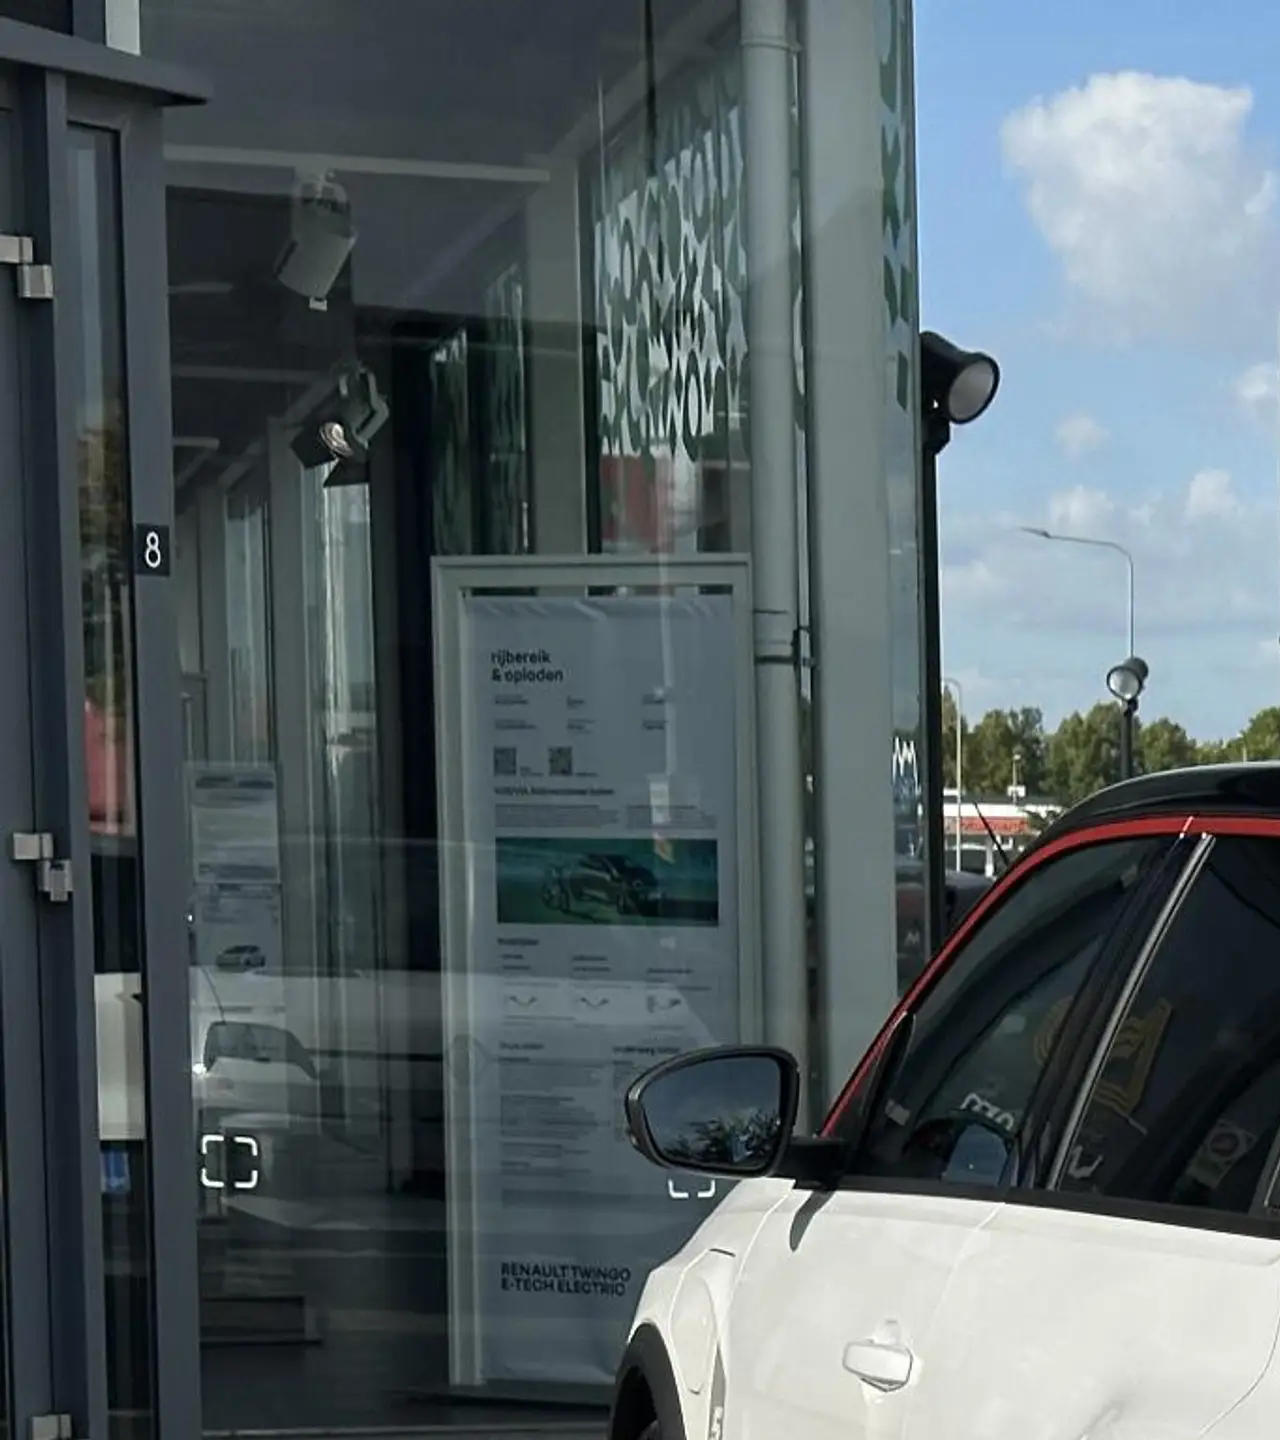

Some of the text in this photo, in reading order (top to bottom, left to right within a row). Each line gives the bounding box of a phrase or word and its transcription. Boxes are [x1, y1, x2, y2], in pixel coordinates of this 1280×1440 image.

[146, 531, 161, 568] 8
[501, 1262, 631, 1282] RENAULT TWINGO
[557, 1280, 626, 1296] ELECTRIC
